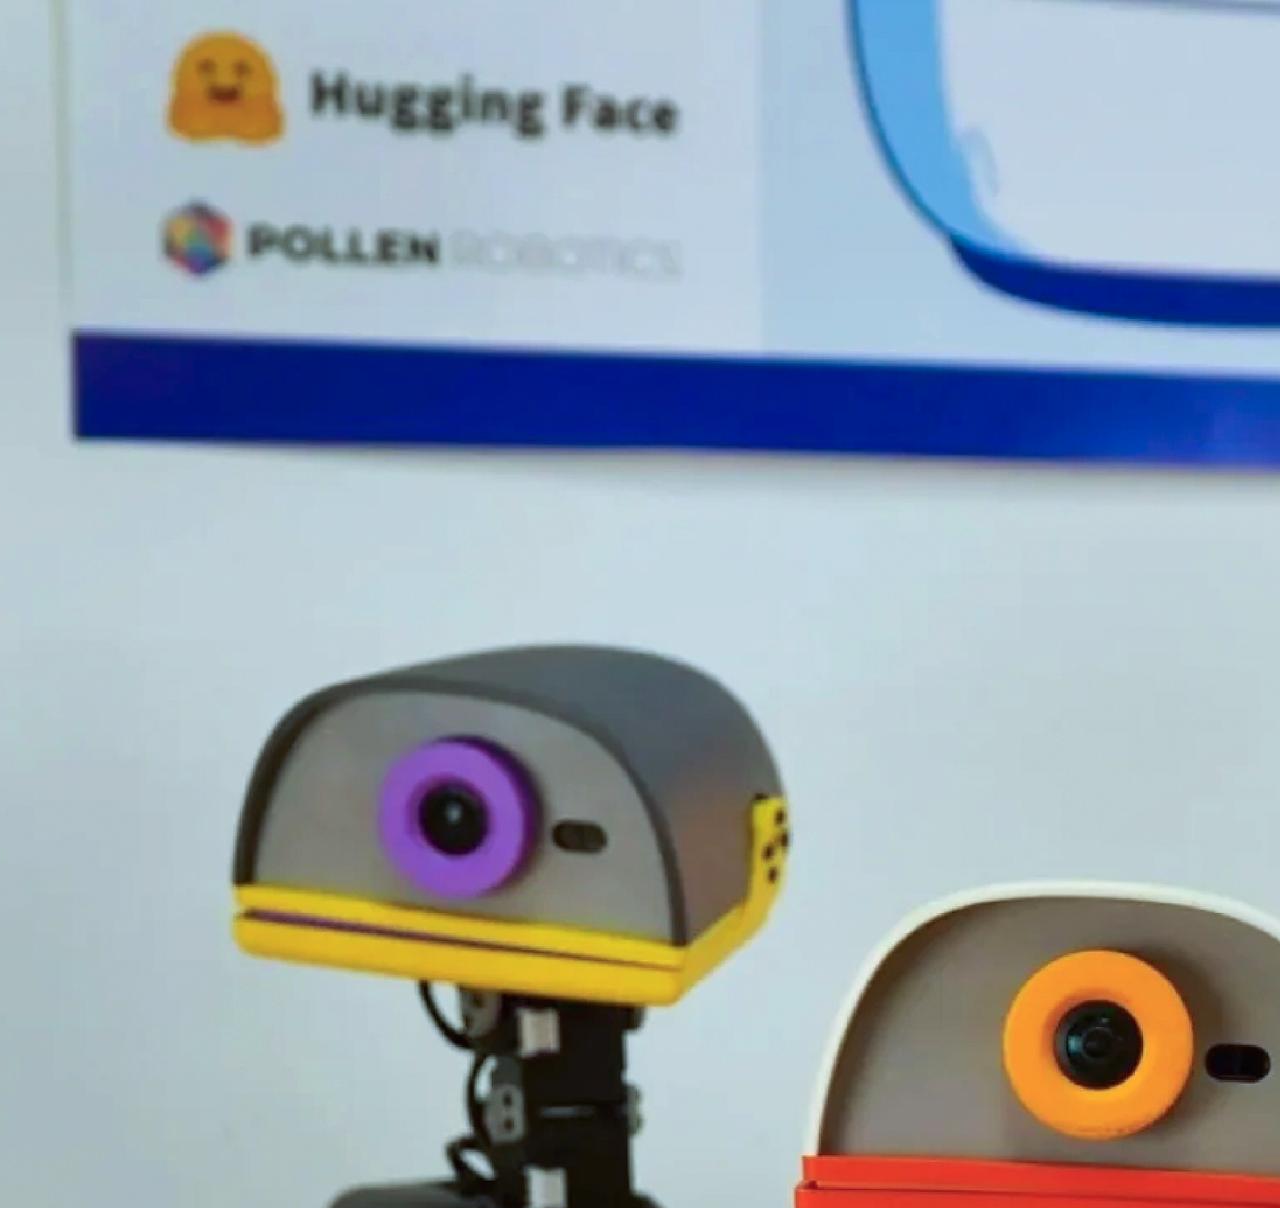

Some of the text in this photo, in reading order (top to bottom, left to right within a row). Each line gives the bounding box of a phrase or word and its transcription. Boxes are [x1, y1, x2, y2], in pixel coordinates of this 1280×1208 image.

[310, 68, 678, 141] Hugging Face
[247, 222, 440, 268] POLLEN
